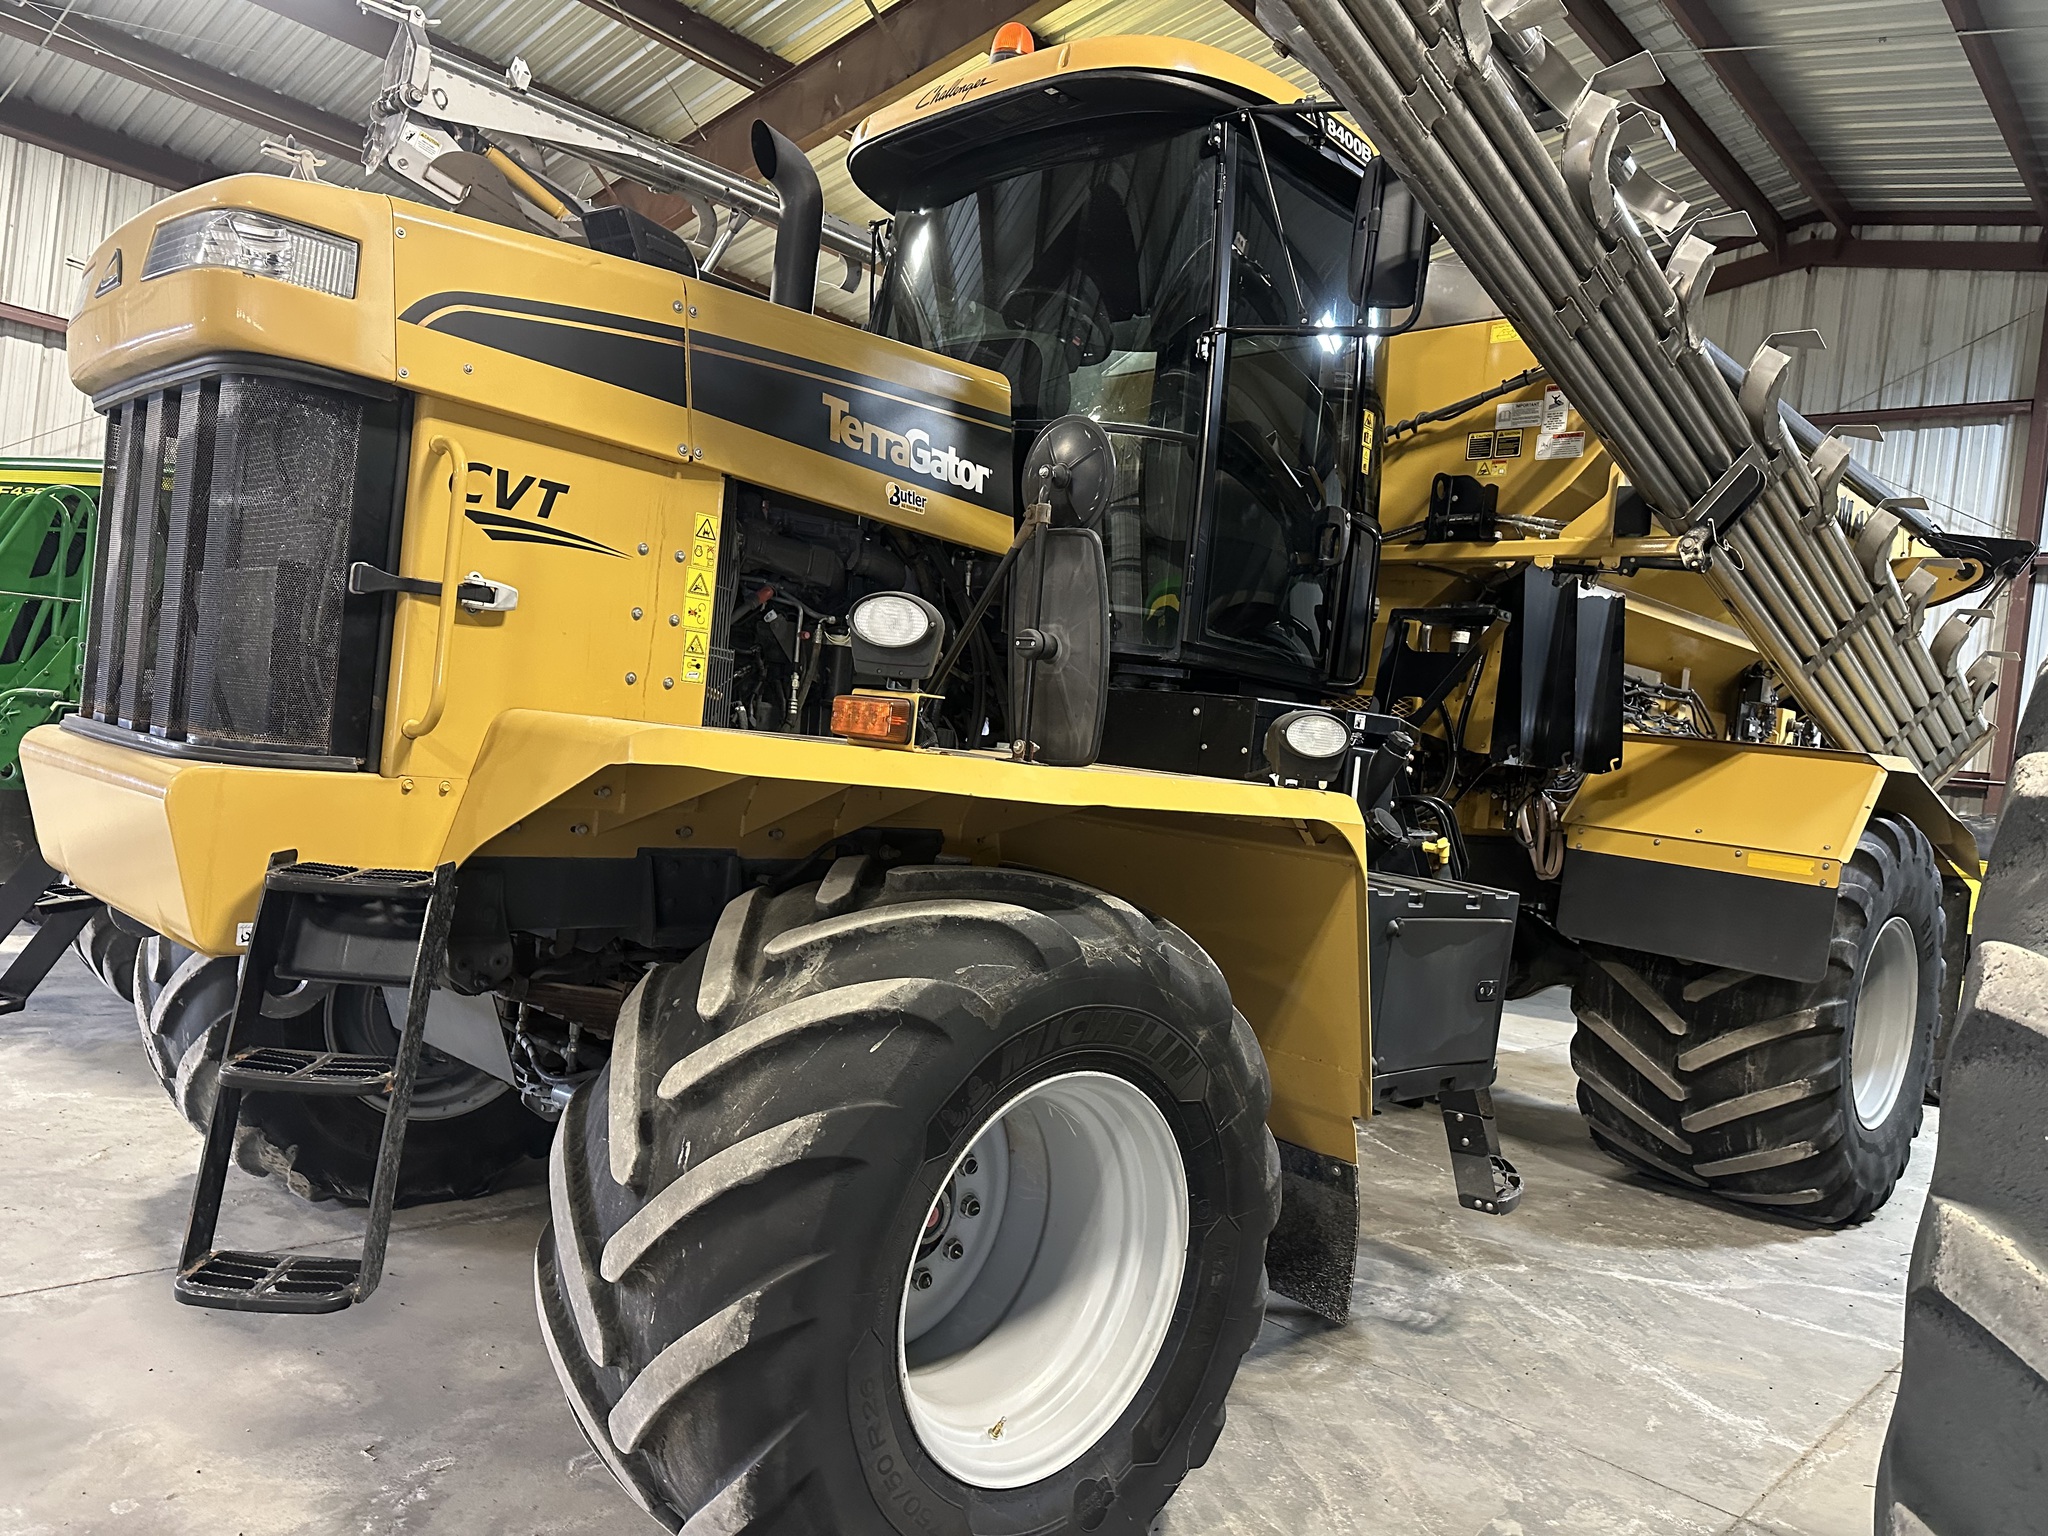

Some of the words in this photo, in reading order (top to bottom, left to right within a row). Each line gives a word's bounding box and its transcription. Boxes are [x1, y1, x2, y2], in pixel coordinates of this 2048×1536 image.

[915, 78, 998, 110] Challenger
[1327, 118, 1372, 162] 8400B
[822, 393, 991, 494] TerraGator
[887, 483, 927, 508] Butler
[1001, 1009, 1199, 1081] MICHELIN
